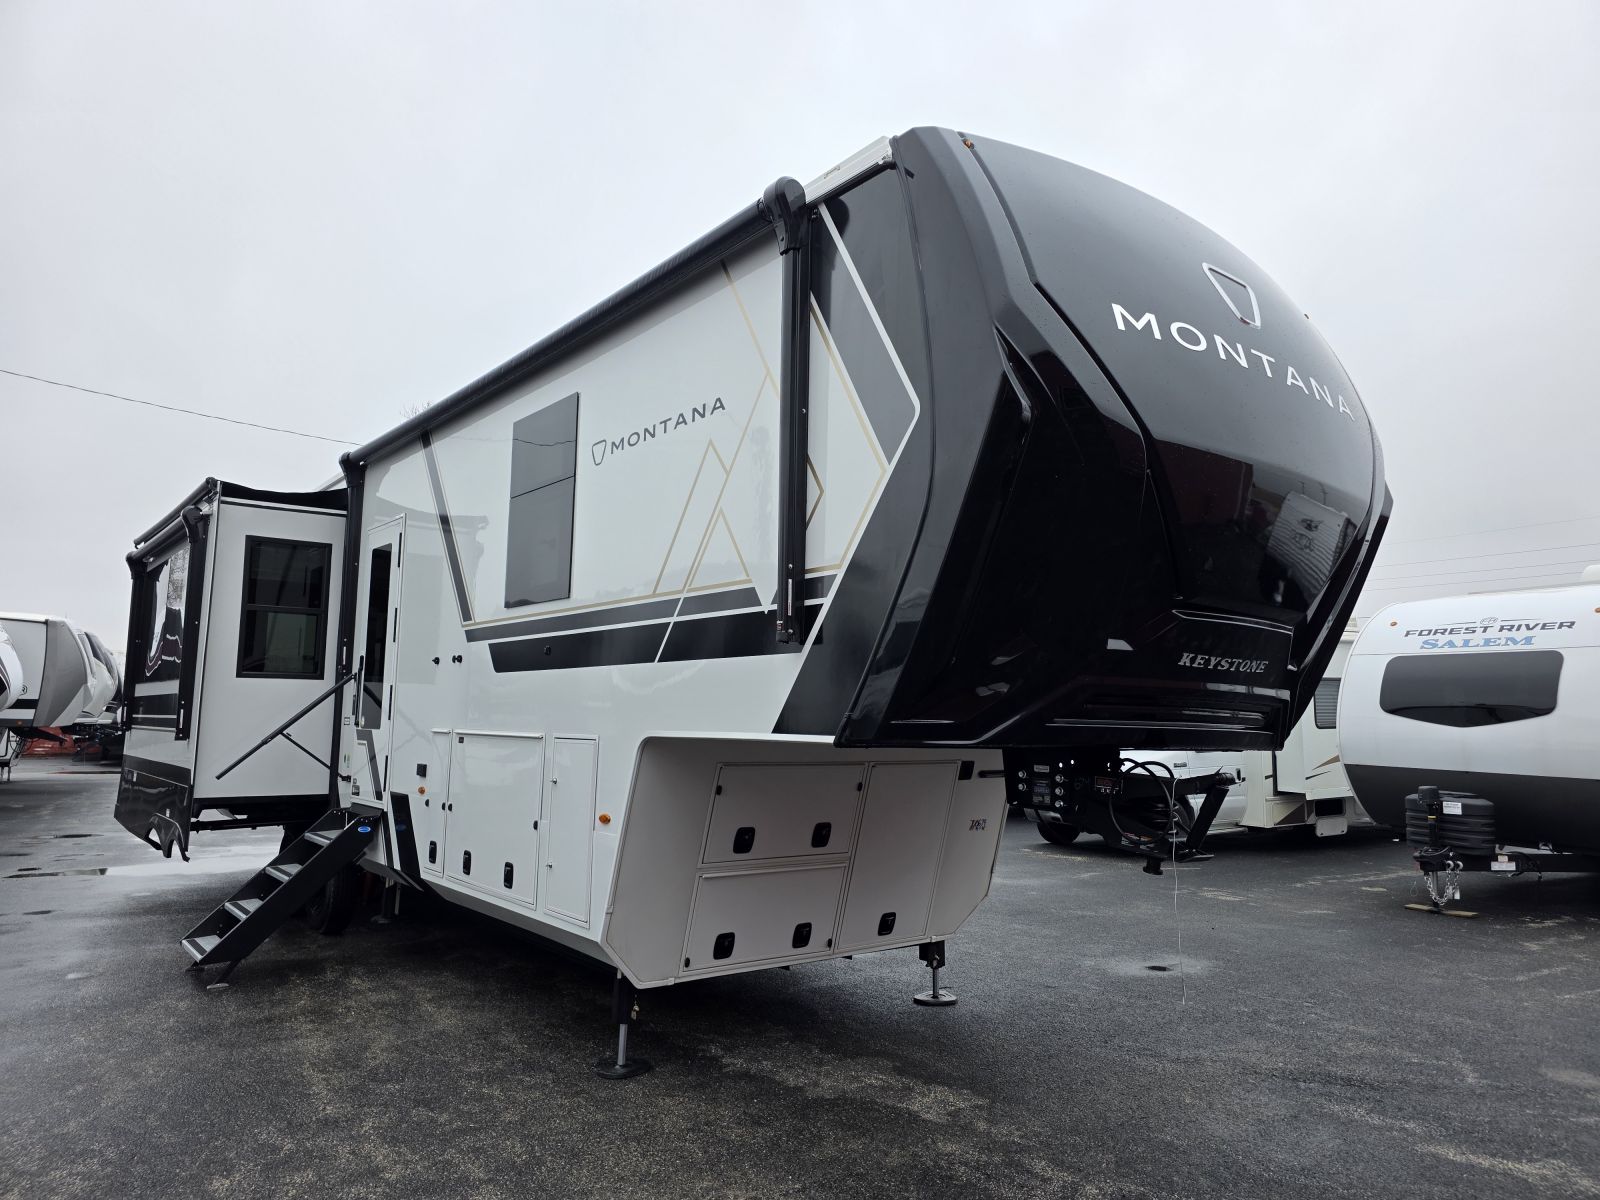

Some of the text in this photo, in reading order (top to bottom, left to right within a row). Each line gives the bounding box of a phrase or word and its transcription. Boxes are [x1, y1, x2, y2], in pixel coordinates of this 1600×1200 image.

[1111, 303, 1355, 421] MONTANA
[610, 397, 725, 454] MONTANA
[1404, 626, 1493, 637] FOREST
[1498, 620, 1576, 632] RIVER
[1419, 635, 1536, 649] SALEM
[1178, 652, 1268, 672] KEYSTONE
